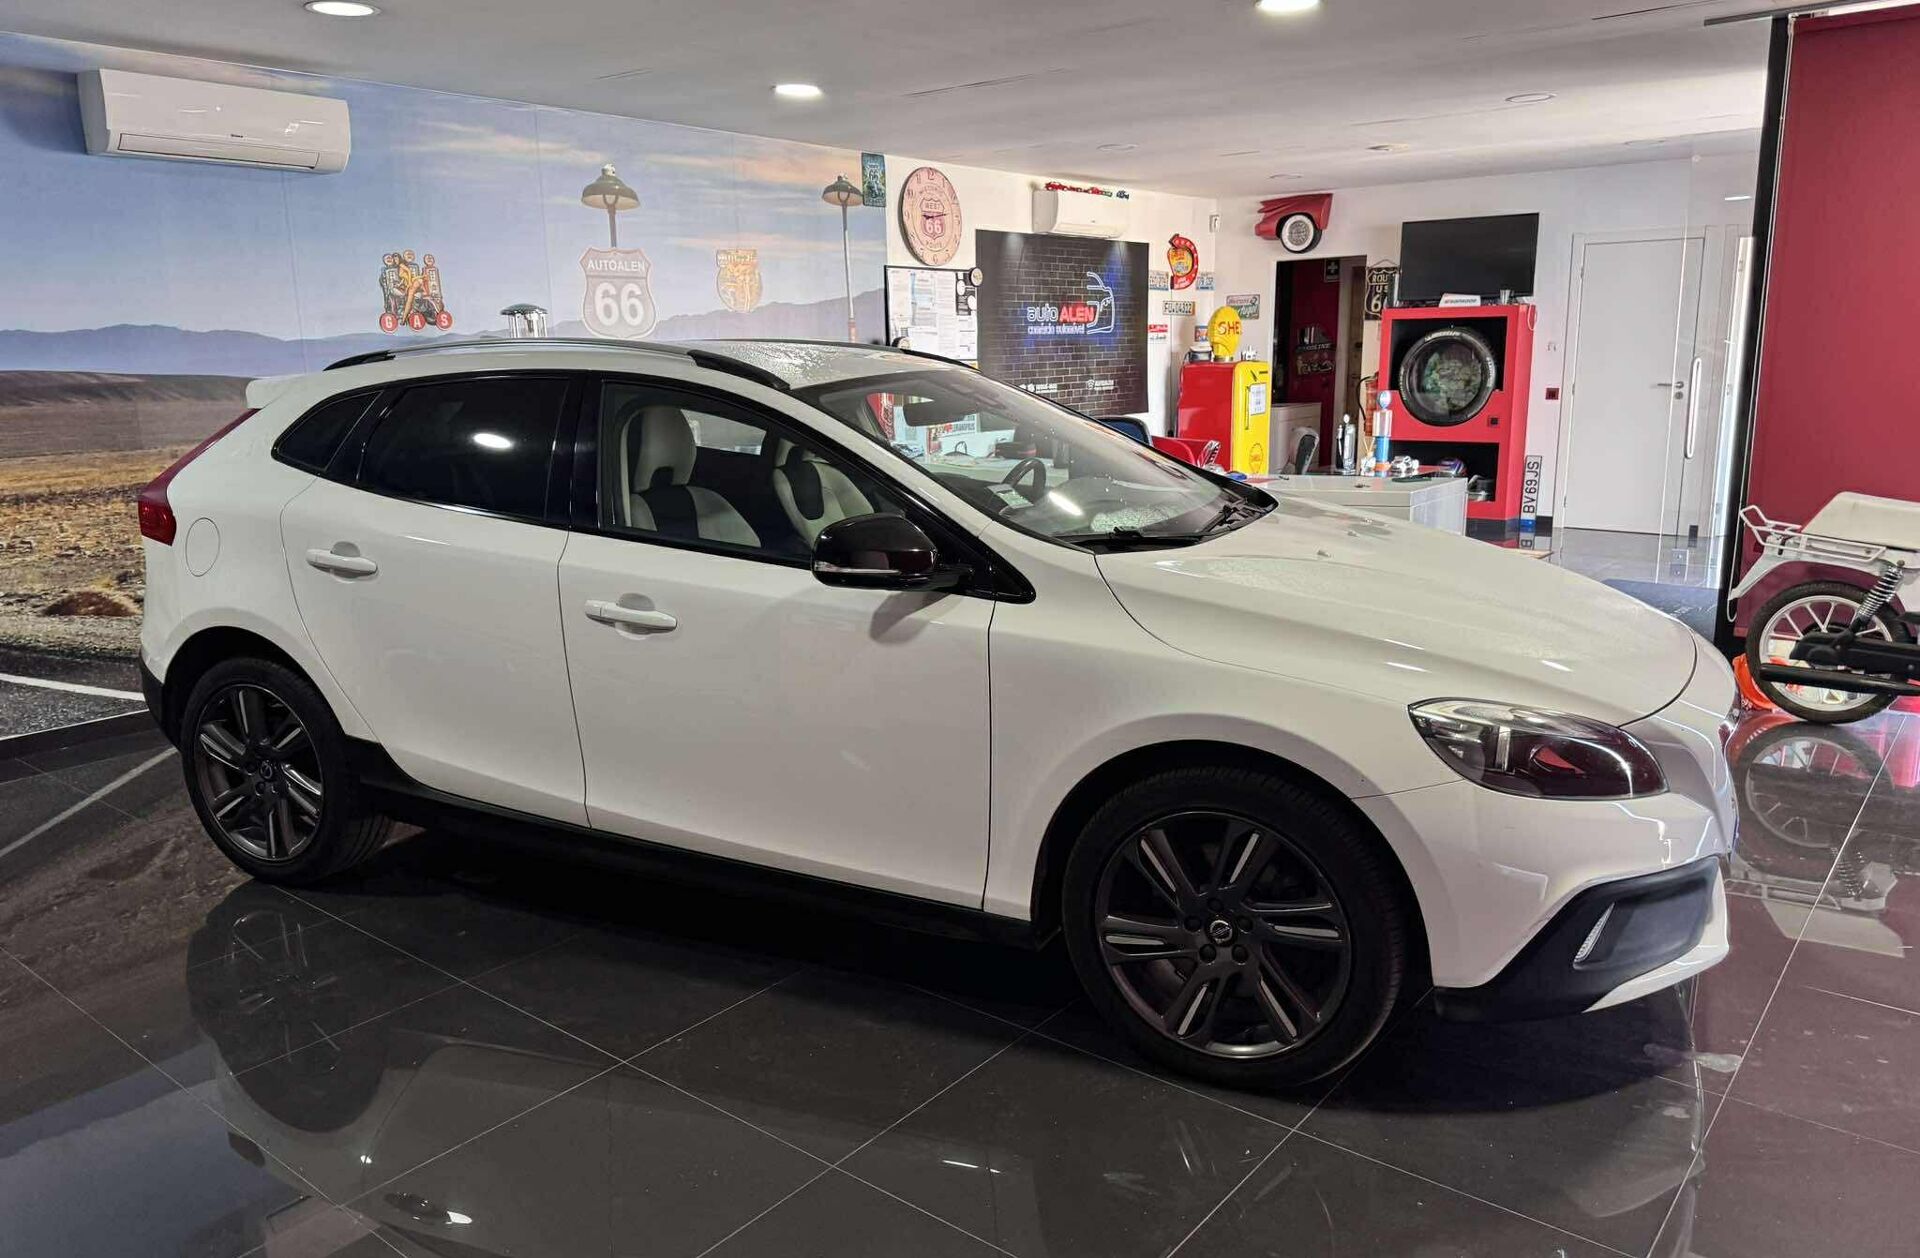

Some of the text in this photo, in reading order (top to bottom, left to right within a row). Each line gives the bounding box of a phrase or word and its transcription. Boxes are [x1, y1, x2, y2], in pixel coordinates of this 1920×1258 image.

[925, 220, 942, 234] 66
[586, 260, 646, 272] AUTOALEN
[1371, 273, 1389, 283] ROU
[594, 282, 644, 327] 66
[1027, 302, 1095, 323] auto ALEN
[1218, 321, 1241, 335] SHE
